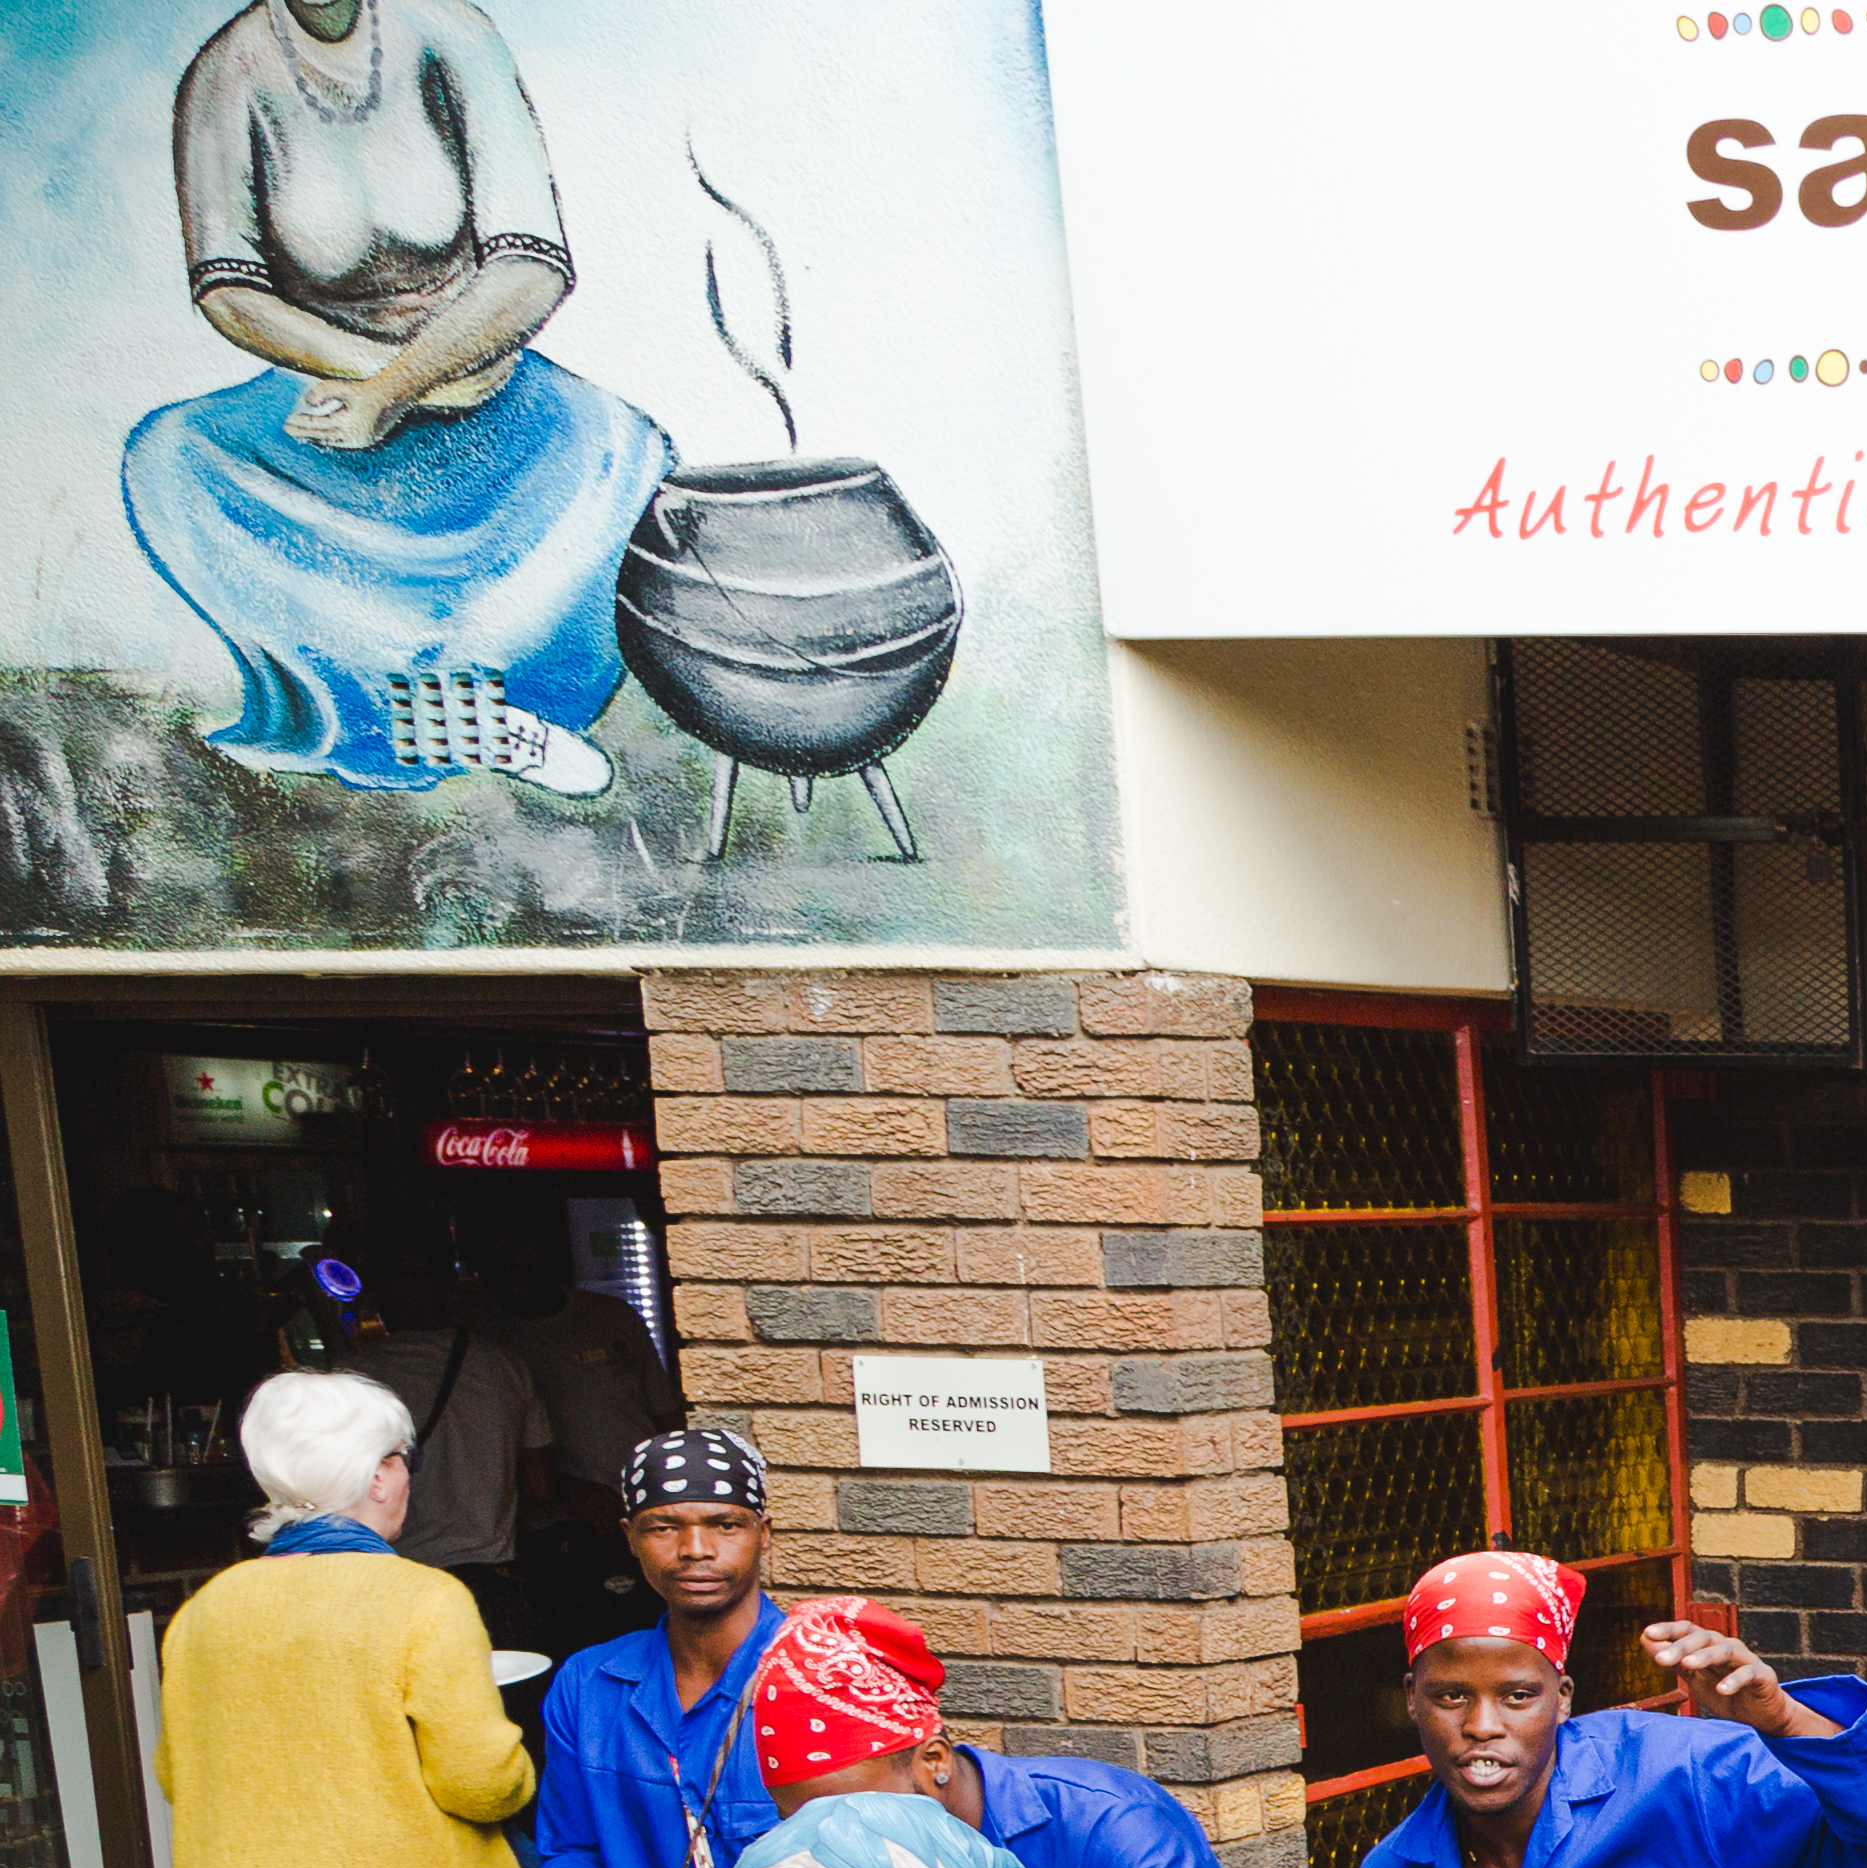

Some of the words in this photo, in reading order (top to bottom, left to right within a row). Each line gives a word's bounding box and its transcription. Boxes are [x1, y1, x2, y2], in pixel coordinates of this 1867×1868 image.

[437, 1127, 529, 1167] Coca-Cola
[861, 1393, 912, 1407] RIGHT
[919, 1394, 939, 1408] OF
[947, 1395, 1040, 1410] ADMISSION
[909, 1418, 997, 1433] RESERVED
